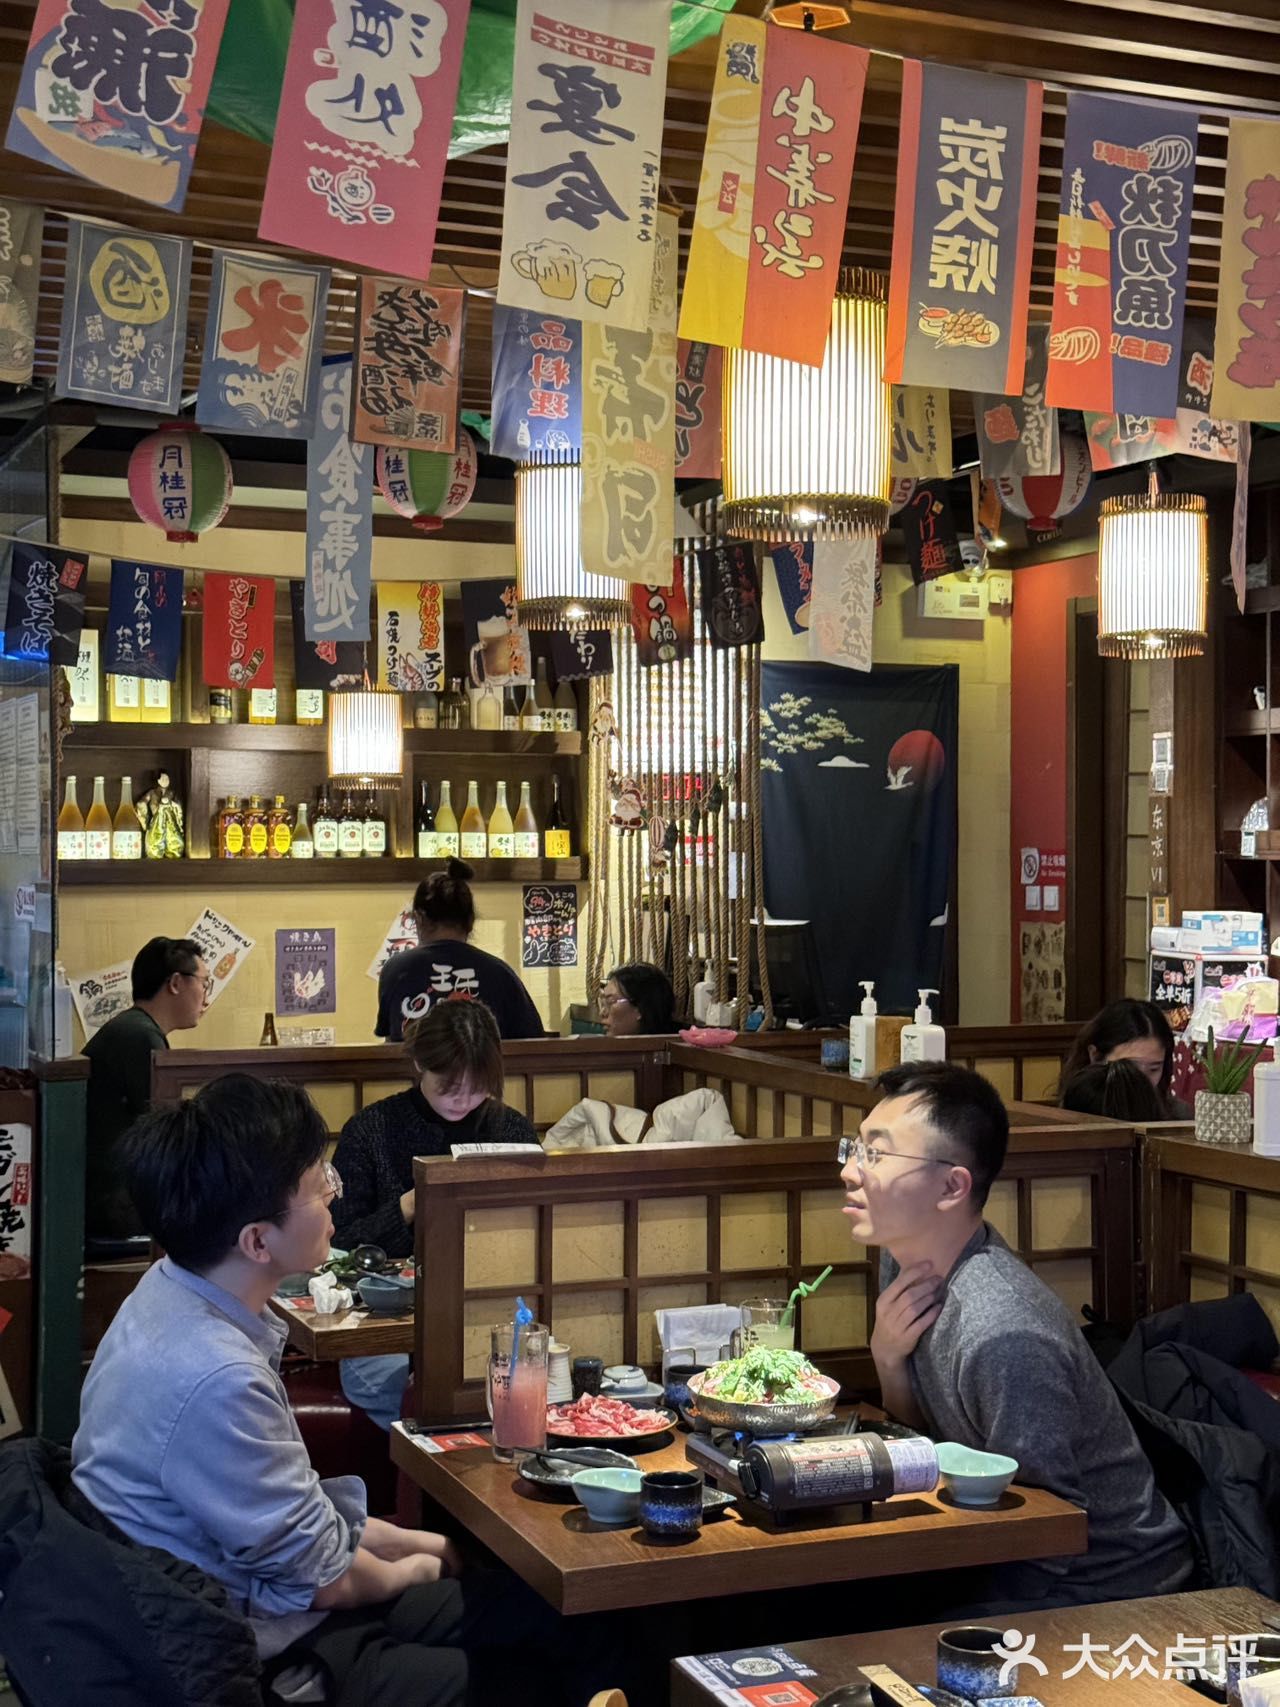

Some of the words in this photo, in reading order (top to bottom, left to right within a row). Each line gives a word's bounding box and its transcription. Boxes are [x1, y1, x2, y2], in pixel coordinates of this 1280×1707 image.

[159, 445, 188, 520] 月桂冠
[228, 577, 250, 660] やきとり
